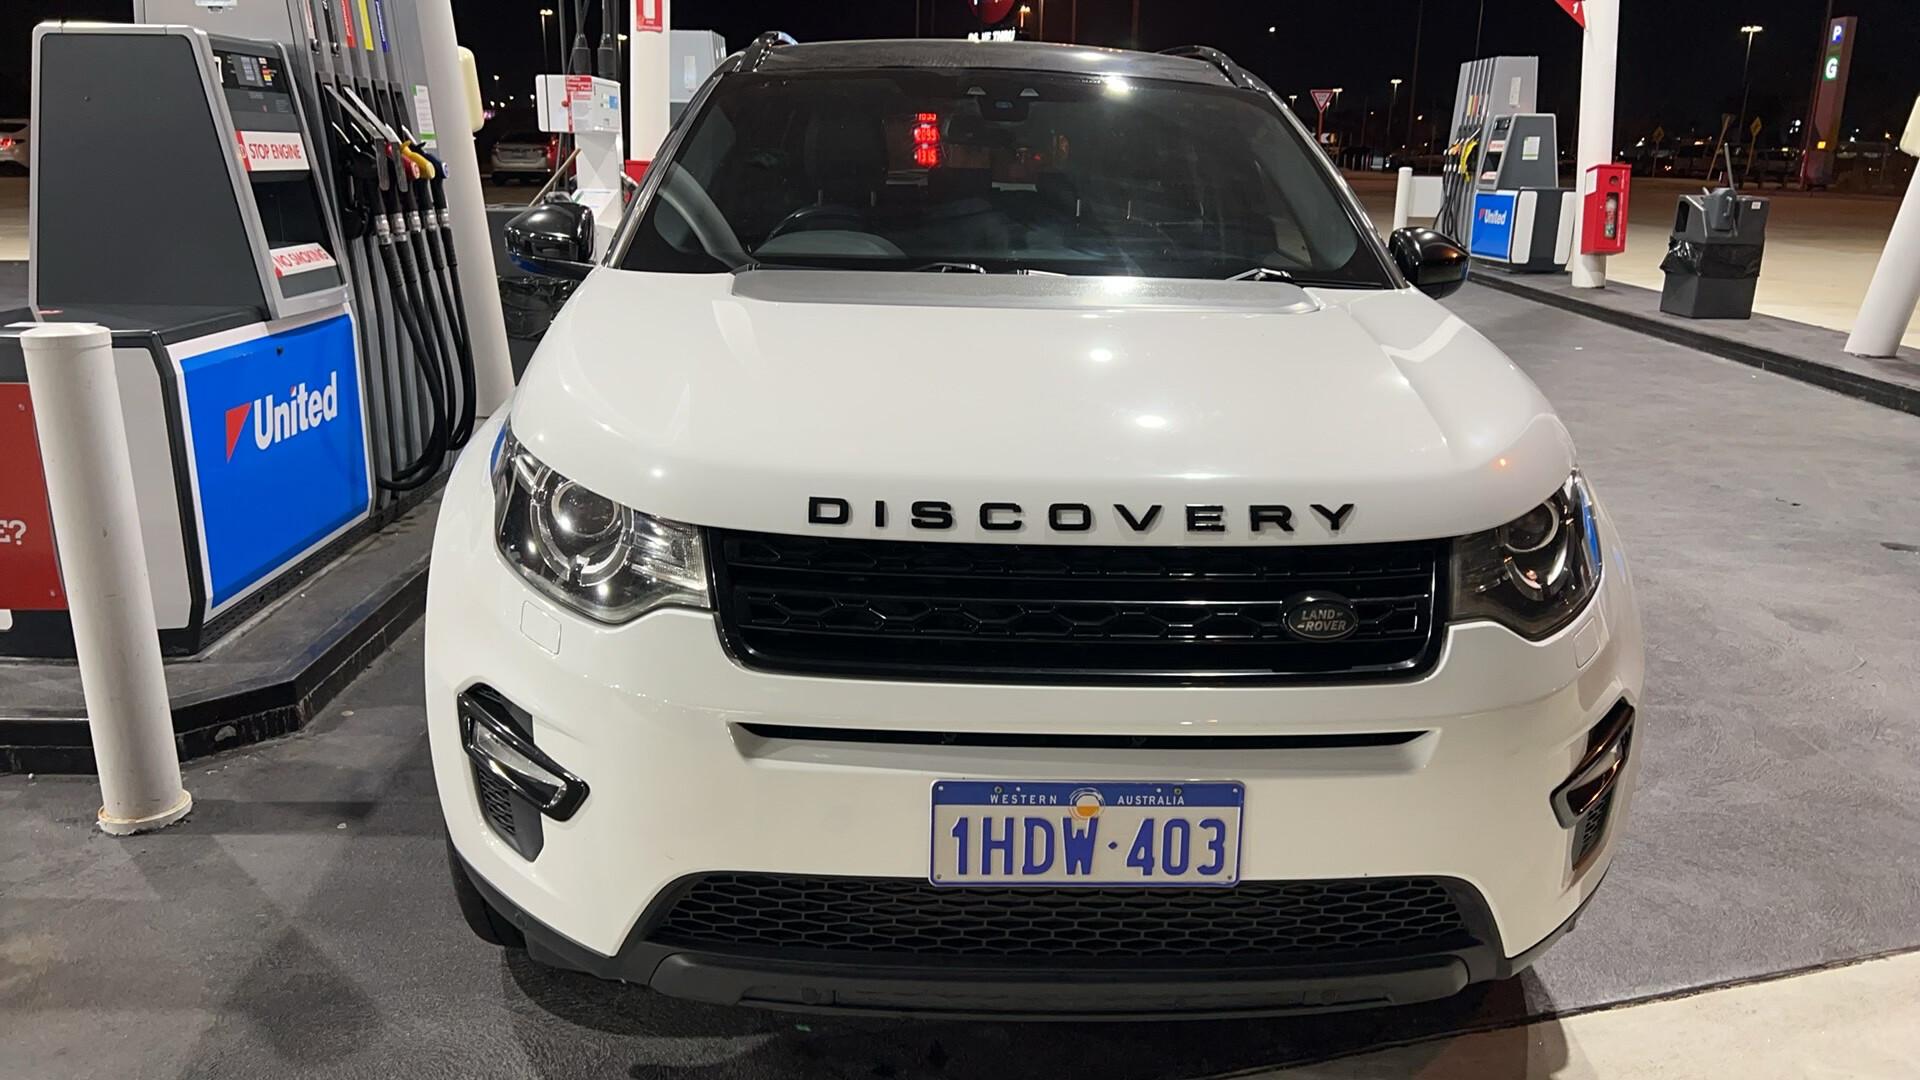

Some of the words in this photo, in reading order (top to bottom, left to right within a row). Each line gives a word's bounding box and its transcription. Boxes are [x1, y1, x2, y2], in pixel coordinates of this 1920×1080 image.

[1832, 25, 1842, 41] P
[1825, 57, 1838, 79] G
[248, 143, 270, 160] STOP
[271, 143, 302, 160] ENGINE
[1484, 208, 1508, 226] United
[274, 255, 293, 268] NO
[291, 248, 330, 266] SMOKING
[253, 370, 338, 450] United
[808, 496, 1354, 532] DISCOVERY
[990, 794, 1057, 805] WESTERN
[1117, 795, 1185, 806] AUSTRALIA
